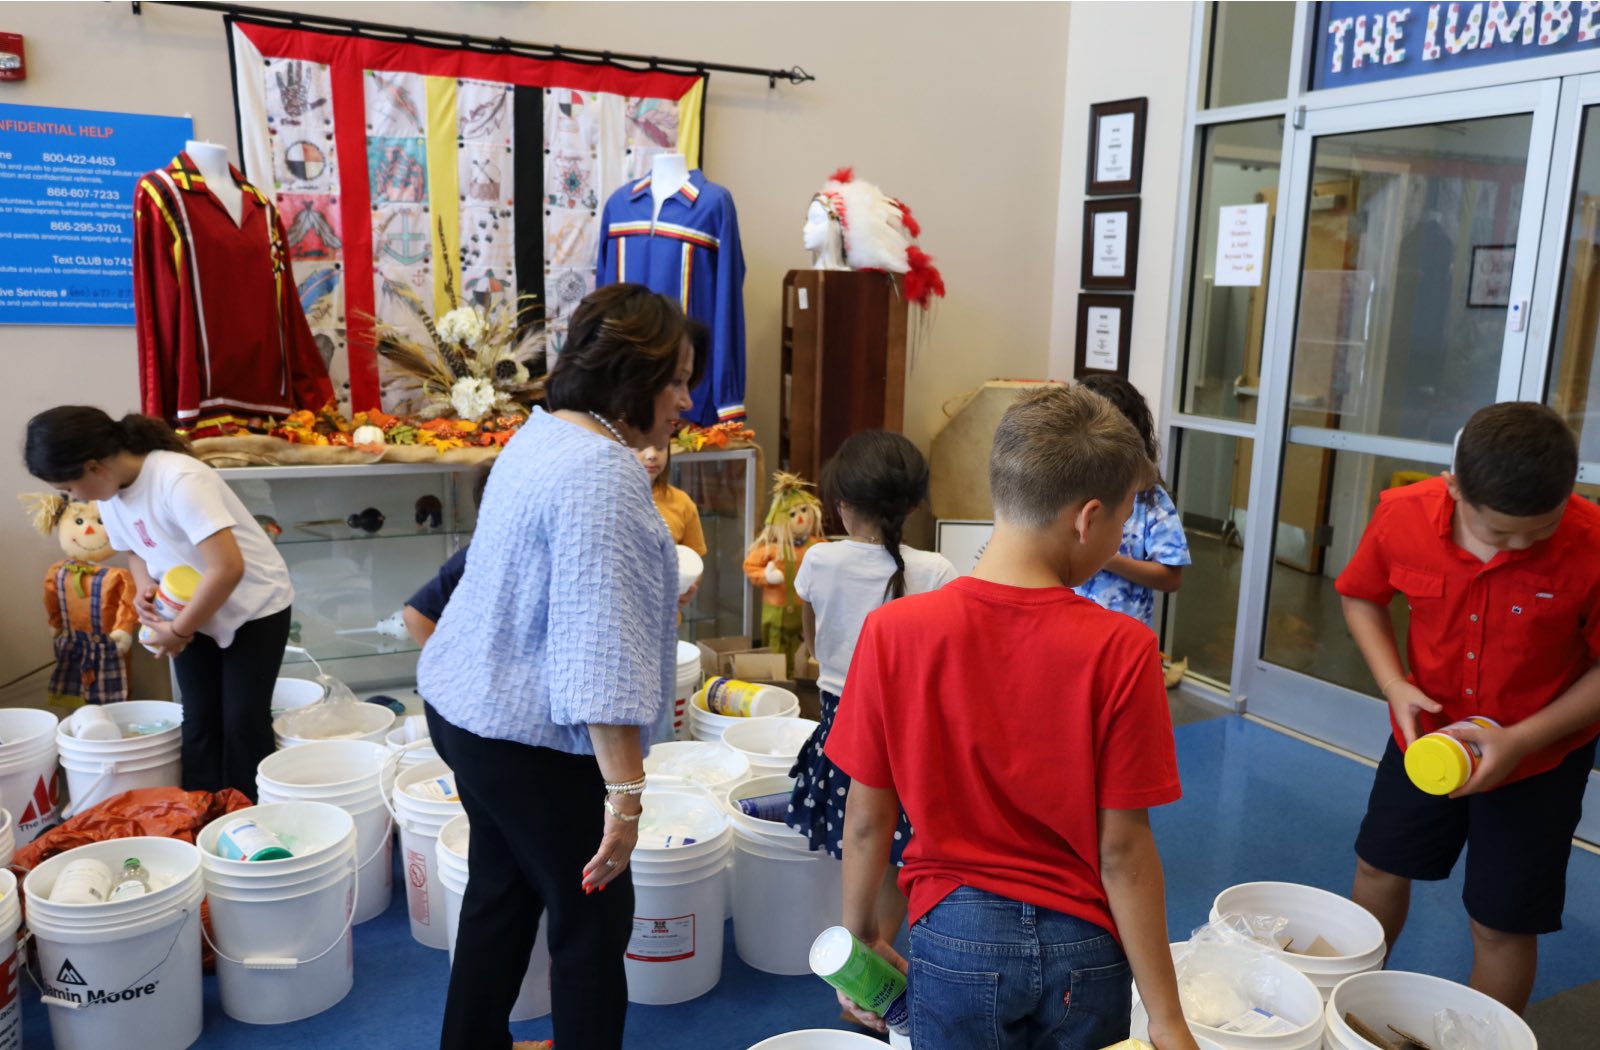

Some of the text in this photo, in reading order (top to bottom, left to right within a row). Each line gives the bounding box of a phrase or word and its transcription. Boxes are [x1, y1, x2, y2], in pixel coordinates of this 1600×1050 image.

[1328, 8, 1411, 73] THE
[79, 125, 115, 138] HELP
[42, 152, 117, 166] 800-422-4453
[50, 221, 122, 234] 866-295-3701
[52, 255, 74, 265] Text
[75, 256, 102, 266] CLUB
[104, 256, 114, 266] to
[16, 288, 58, 298] Services
[86, 982, 155, 1004] Moore
